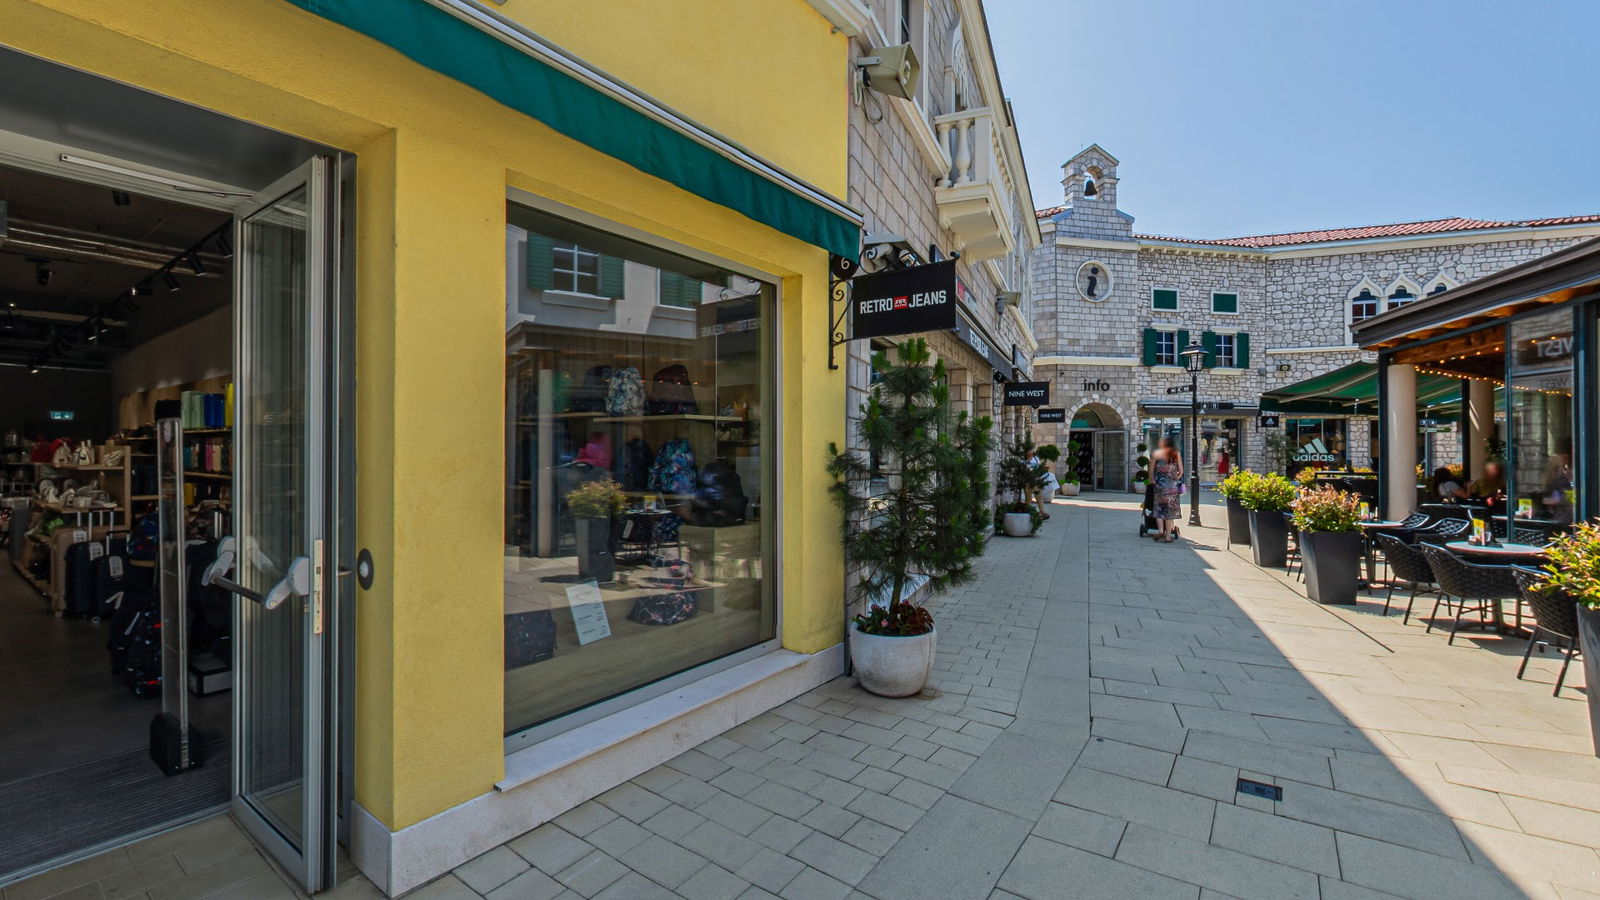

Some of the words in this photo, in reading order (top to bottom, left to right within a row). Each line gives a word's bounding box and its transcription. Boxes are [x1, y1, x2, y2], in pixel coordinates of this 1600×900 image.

[840, 257, 850, 270] 6
[860, 297, 893, 314] RETRO
[908, 290, 947, 308] JEANS
[1083, 379, 1111, 392] info
[1292, 452, 1335, 462] adidas
